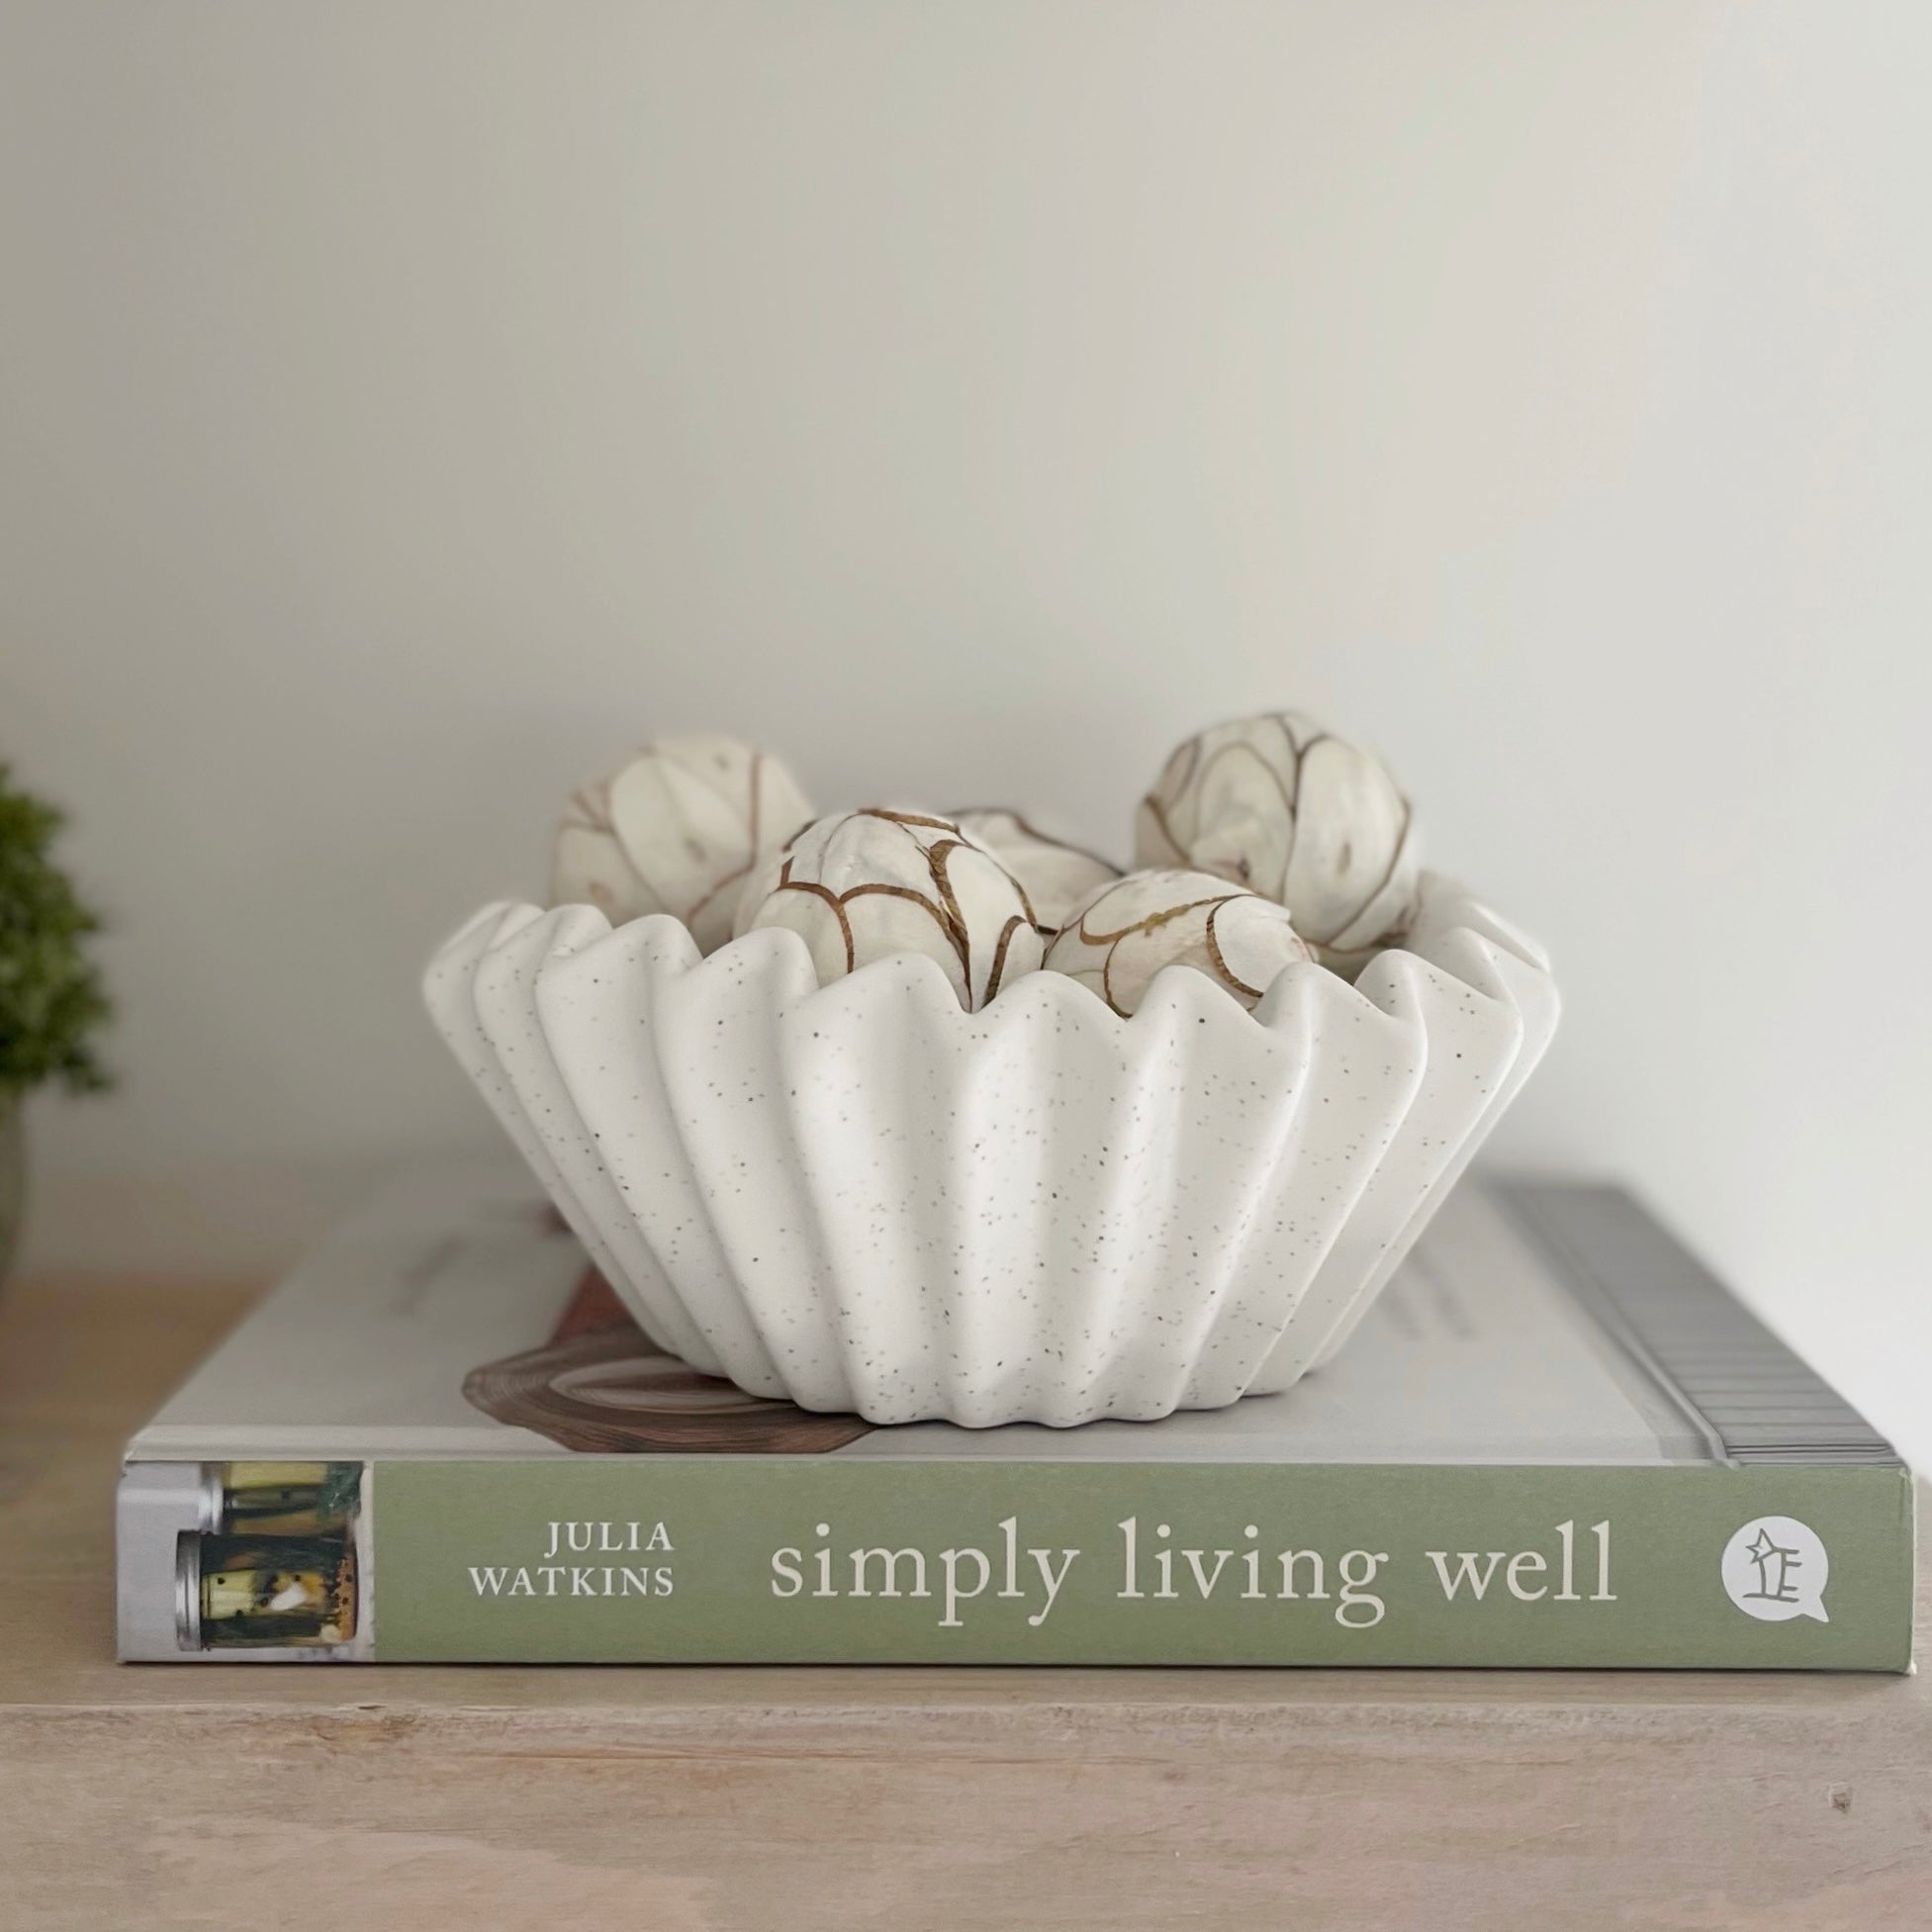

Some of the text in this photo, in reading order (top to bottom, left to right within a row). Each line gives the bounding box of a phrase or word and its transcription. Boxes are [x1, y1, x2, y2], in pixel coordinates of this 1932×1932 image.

[543, 1521, 674, 1559] JULIA
[468, 1566, 674, 1597] WATKINS
[772, 1516, 1617, 1628] simply living well
